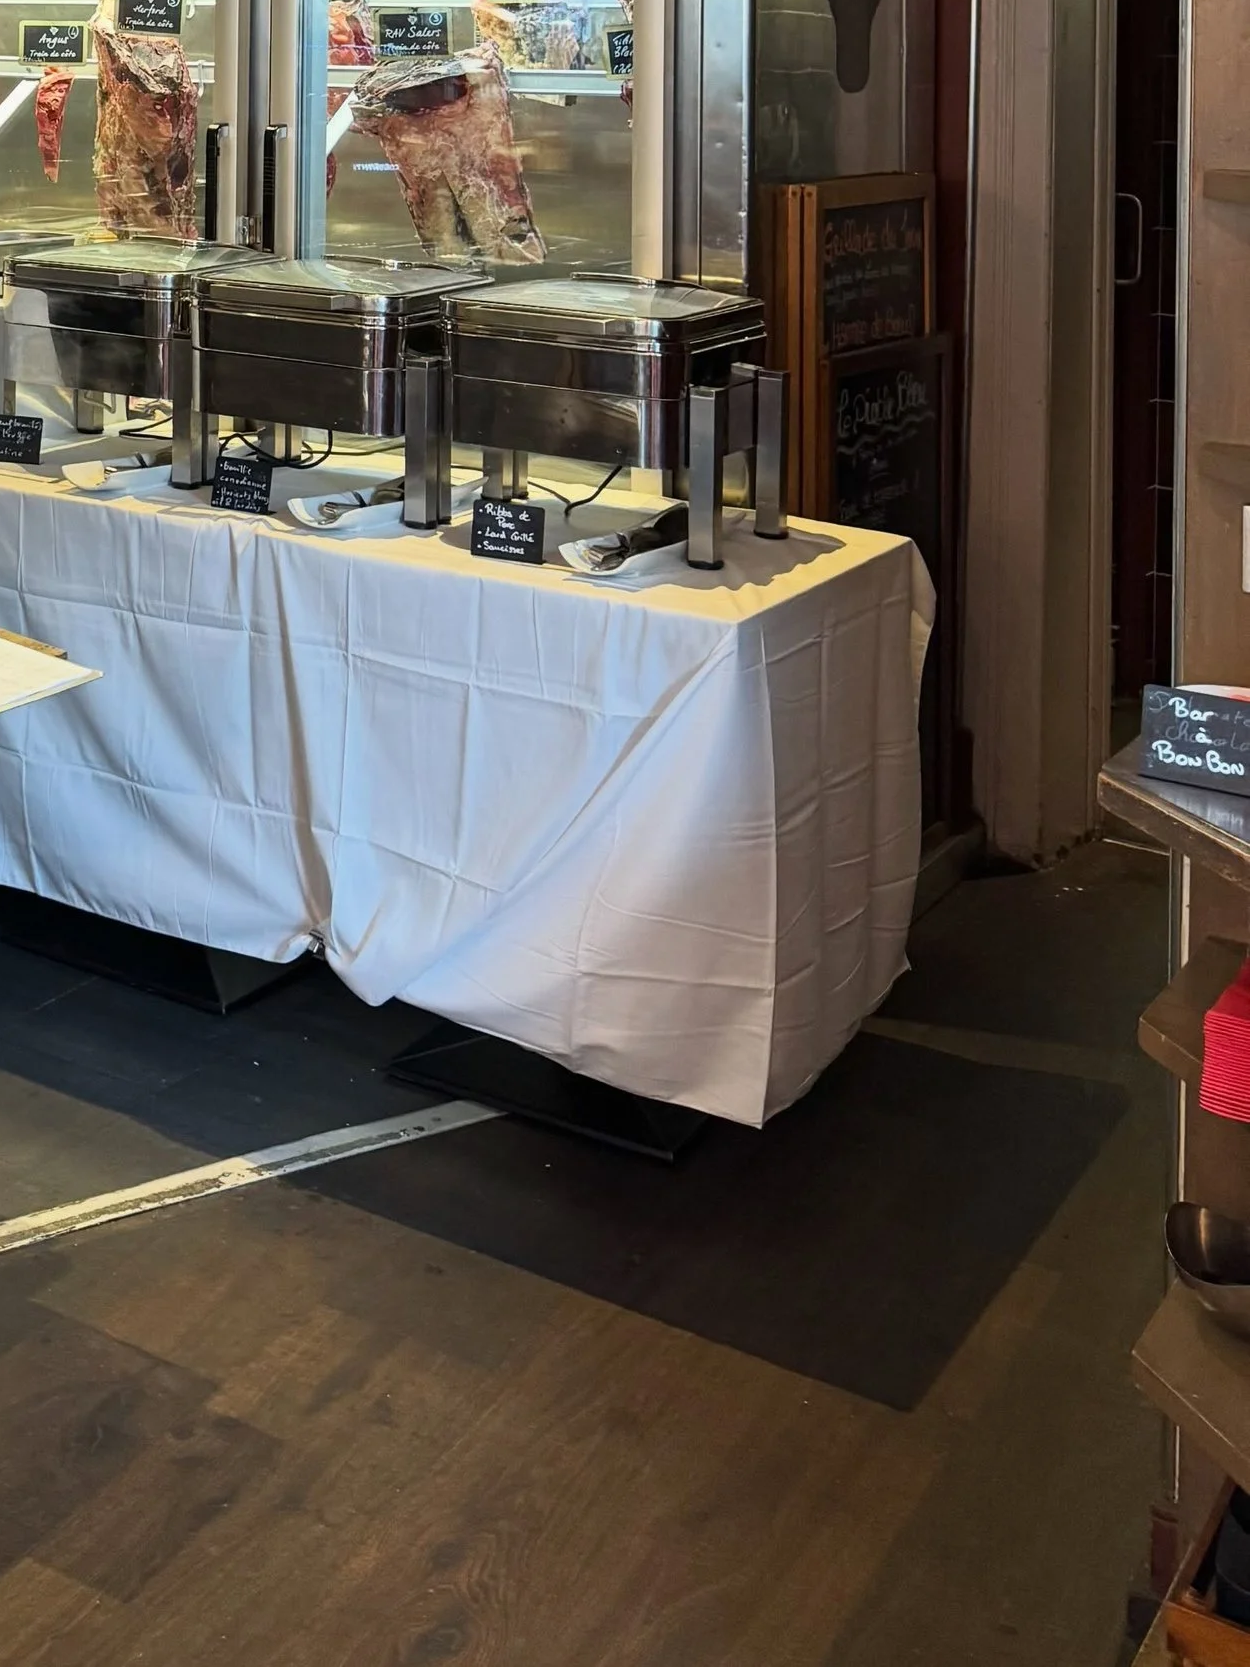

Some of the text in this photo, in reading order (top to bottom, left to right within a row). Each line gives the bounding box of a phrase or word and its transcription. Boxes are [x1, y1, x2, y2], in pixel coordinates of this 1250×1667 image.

[146, 19, 156, 27] de
[385, 25, 441, 38] RAV Salers
[39, 33, 69, 49] Angus
[1168, 697, 1216, 722] Bar
